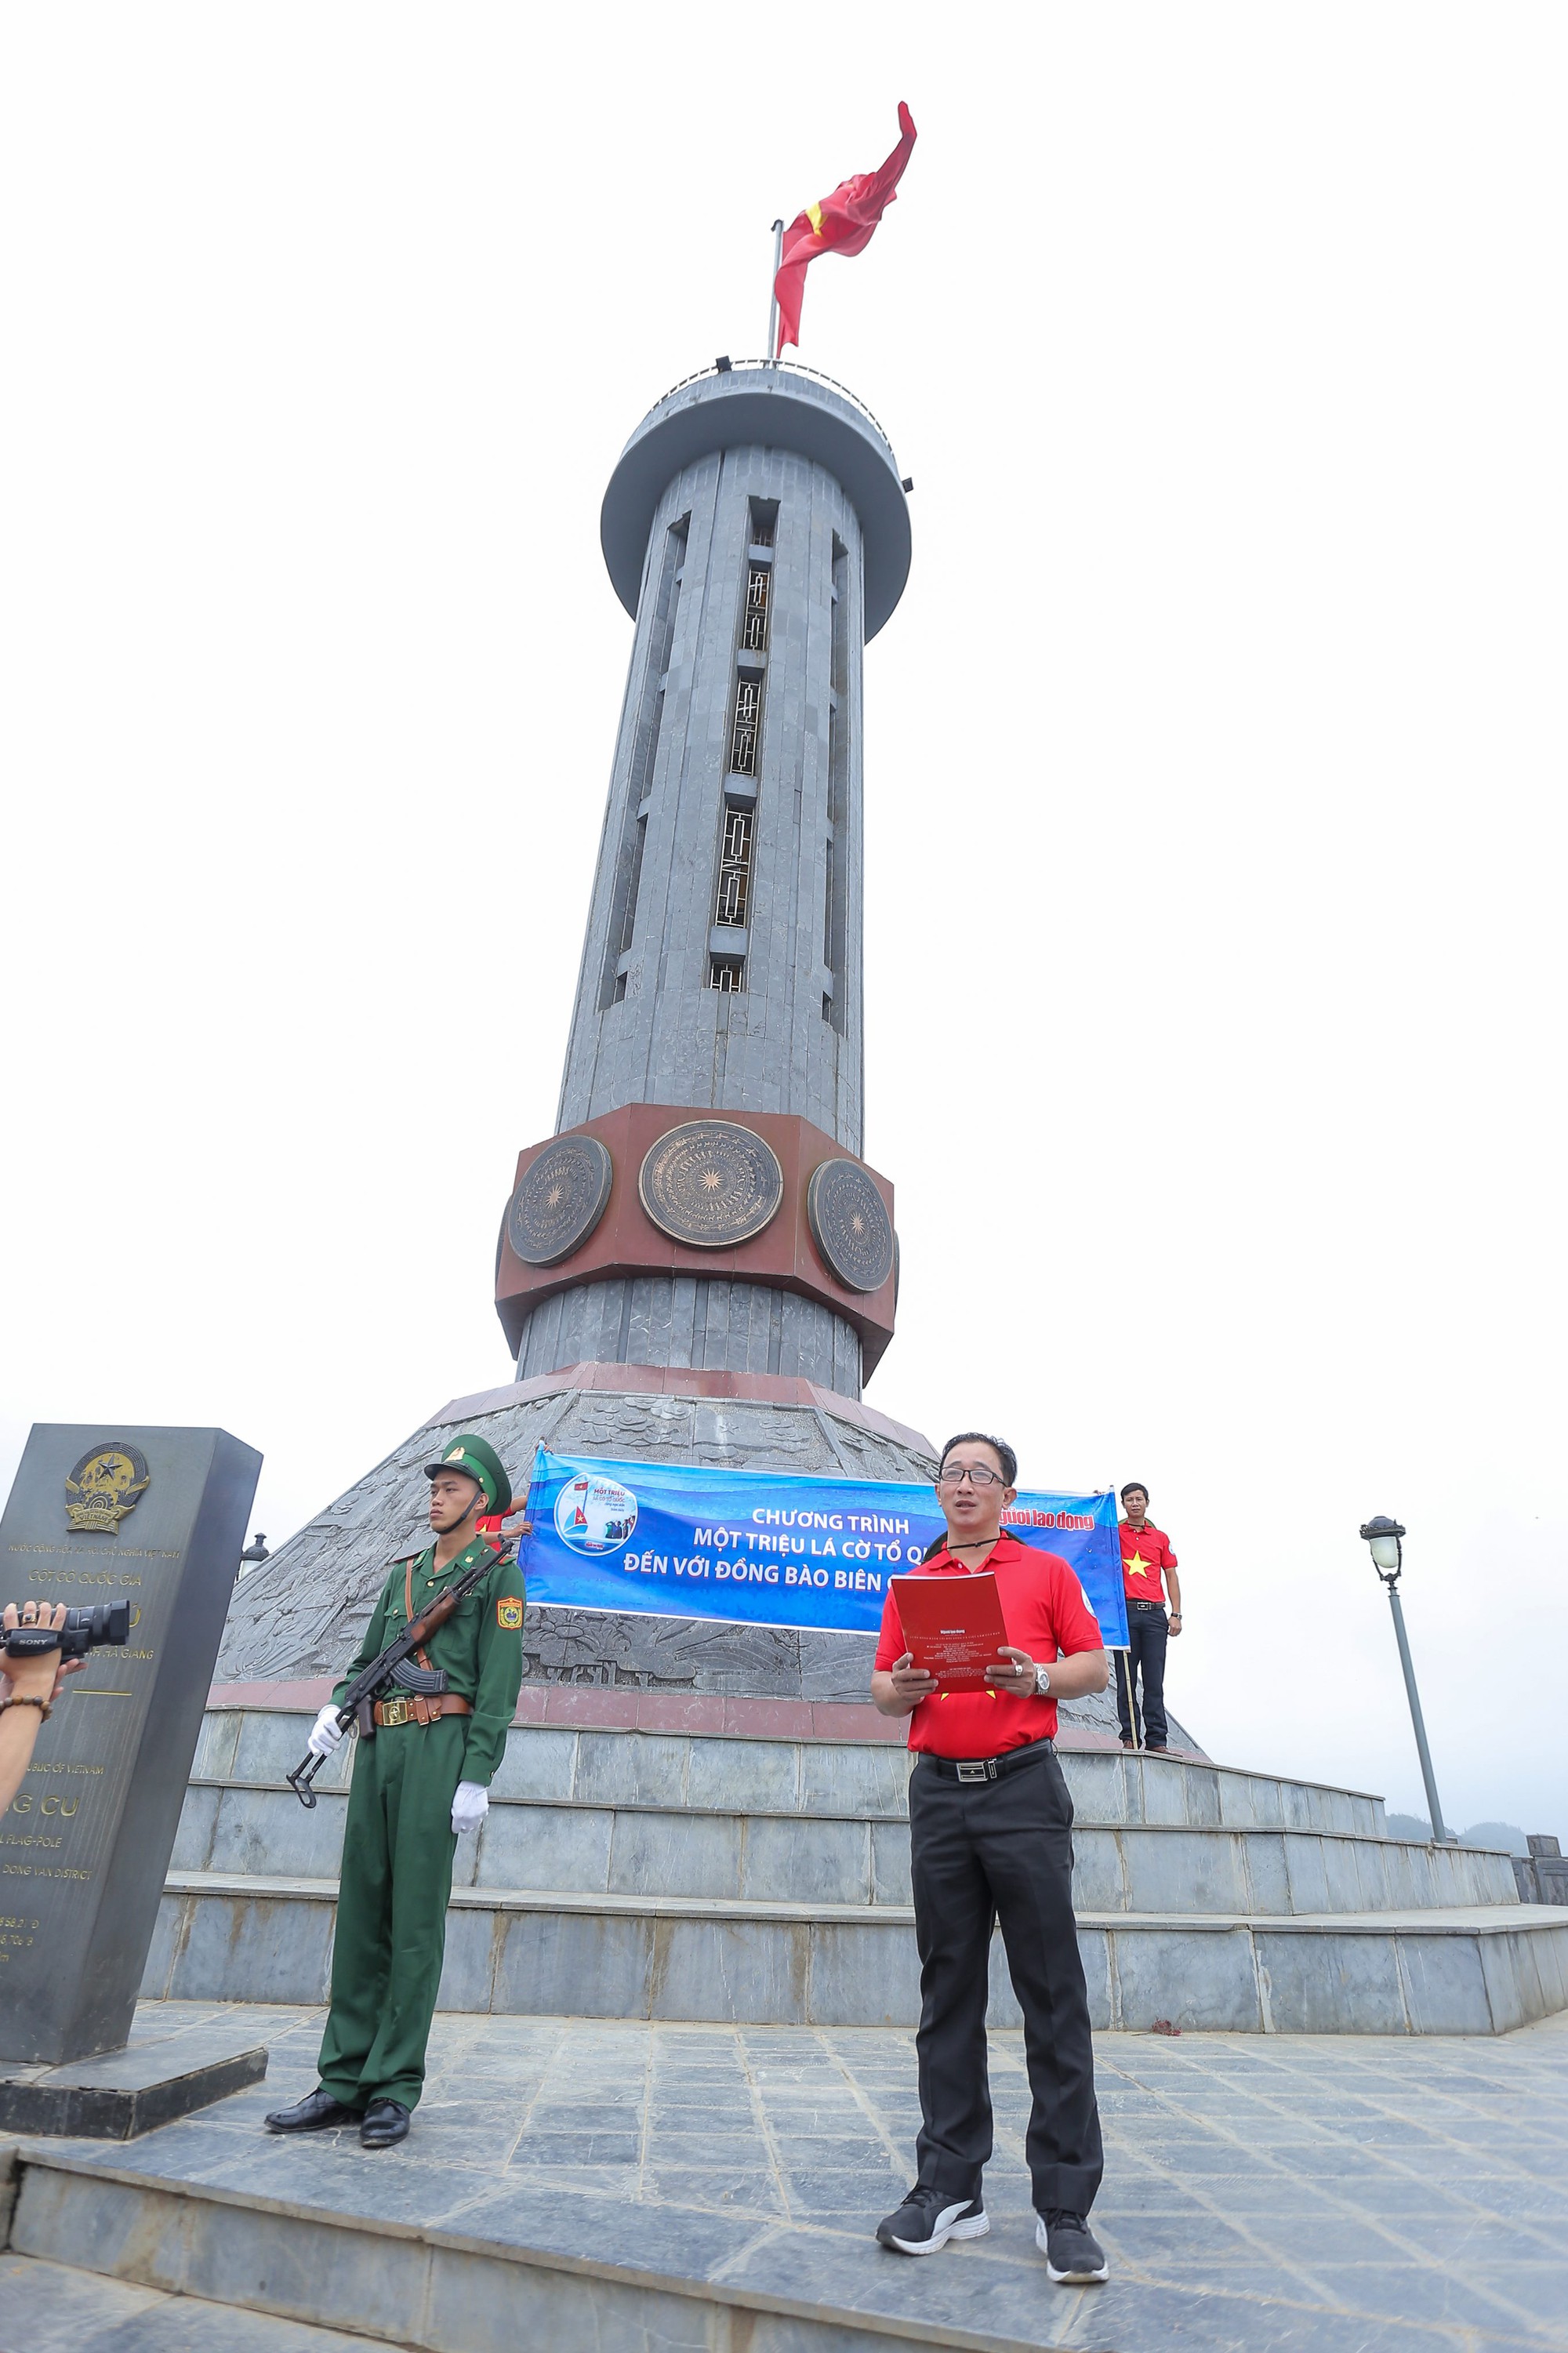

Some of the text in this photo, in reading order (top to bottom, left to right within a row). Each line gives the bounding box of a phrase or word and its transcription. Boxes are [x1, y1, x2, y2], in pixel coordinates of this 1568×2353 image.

[752, 1508, 910, 1535] CHƯƠNG TRÌNH
[1032, 1509, 1055, 1527] lao
[693, 1527, 741, 1552] MỘT
[746, 1533, 805, 1558] TRIỆU
[811, 1537, 837, 1557] LÁ
[842, 1539, 872, 1560] CỜ
[874, 1539, 903, 1563] TỔ
[28, 1568, 56, 1584] CỘT
[78, 1570, 117, 1585] QUỐC
[119, 1574, 141, 1586] GIA
[623, 1550, 670, 1575] ĐẾN
[673, 1555, 711, 1578] VỚI
[714, 1557, 780, 1584] ĐỒNG
[785, 1563, 830, 1589] BÀO
[834, 1568, 883, 1592] BIÊN
[121, 1648, 154, 1660] GIANG
[67, 1764, 104, 1774] VIETNAM
[41, 1794, 79, 1817] CU
[5, 1834, 63, 1848] FLAG-POLE
